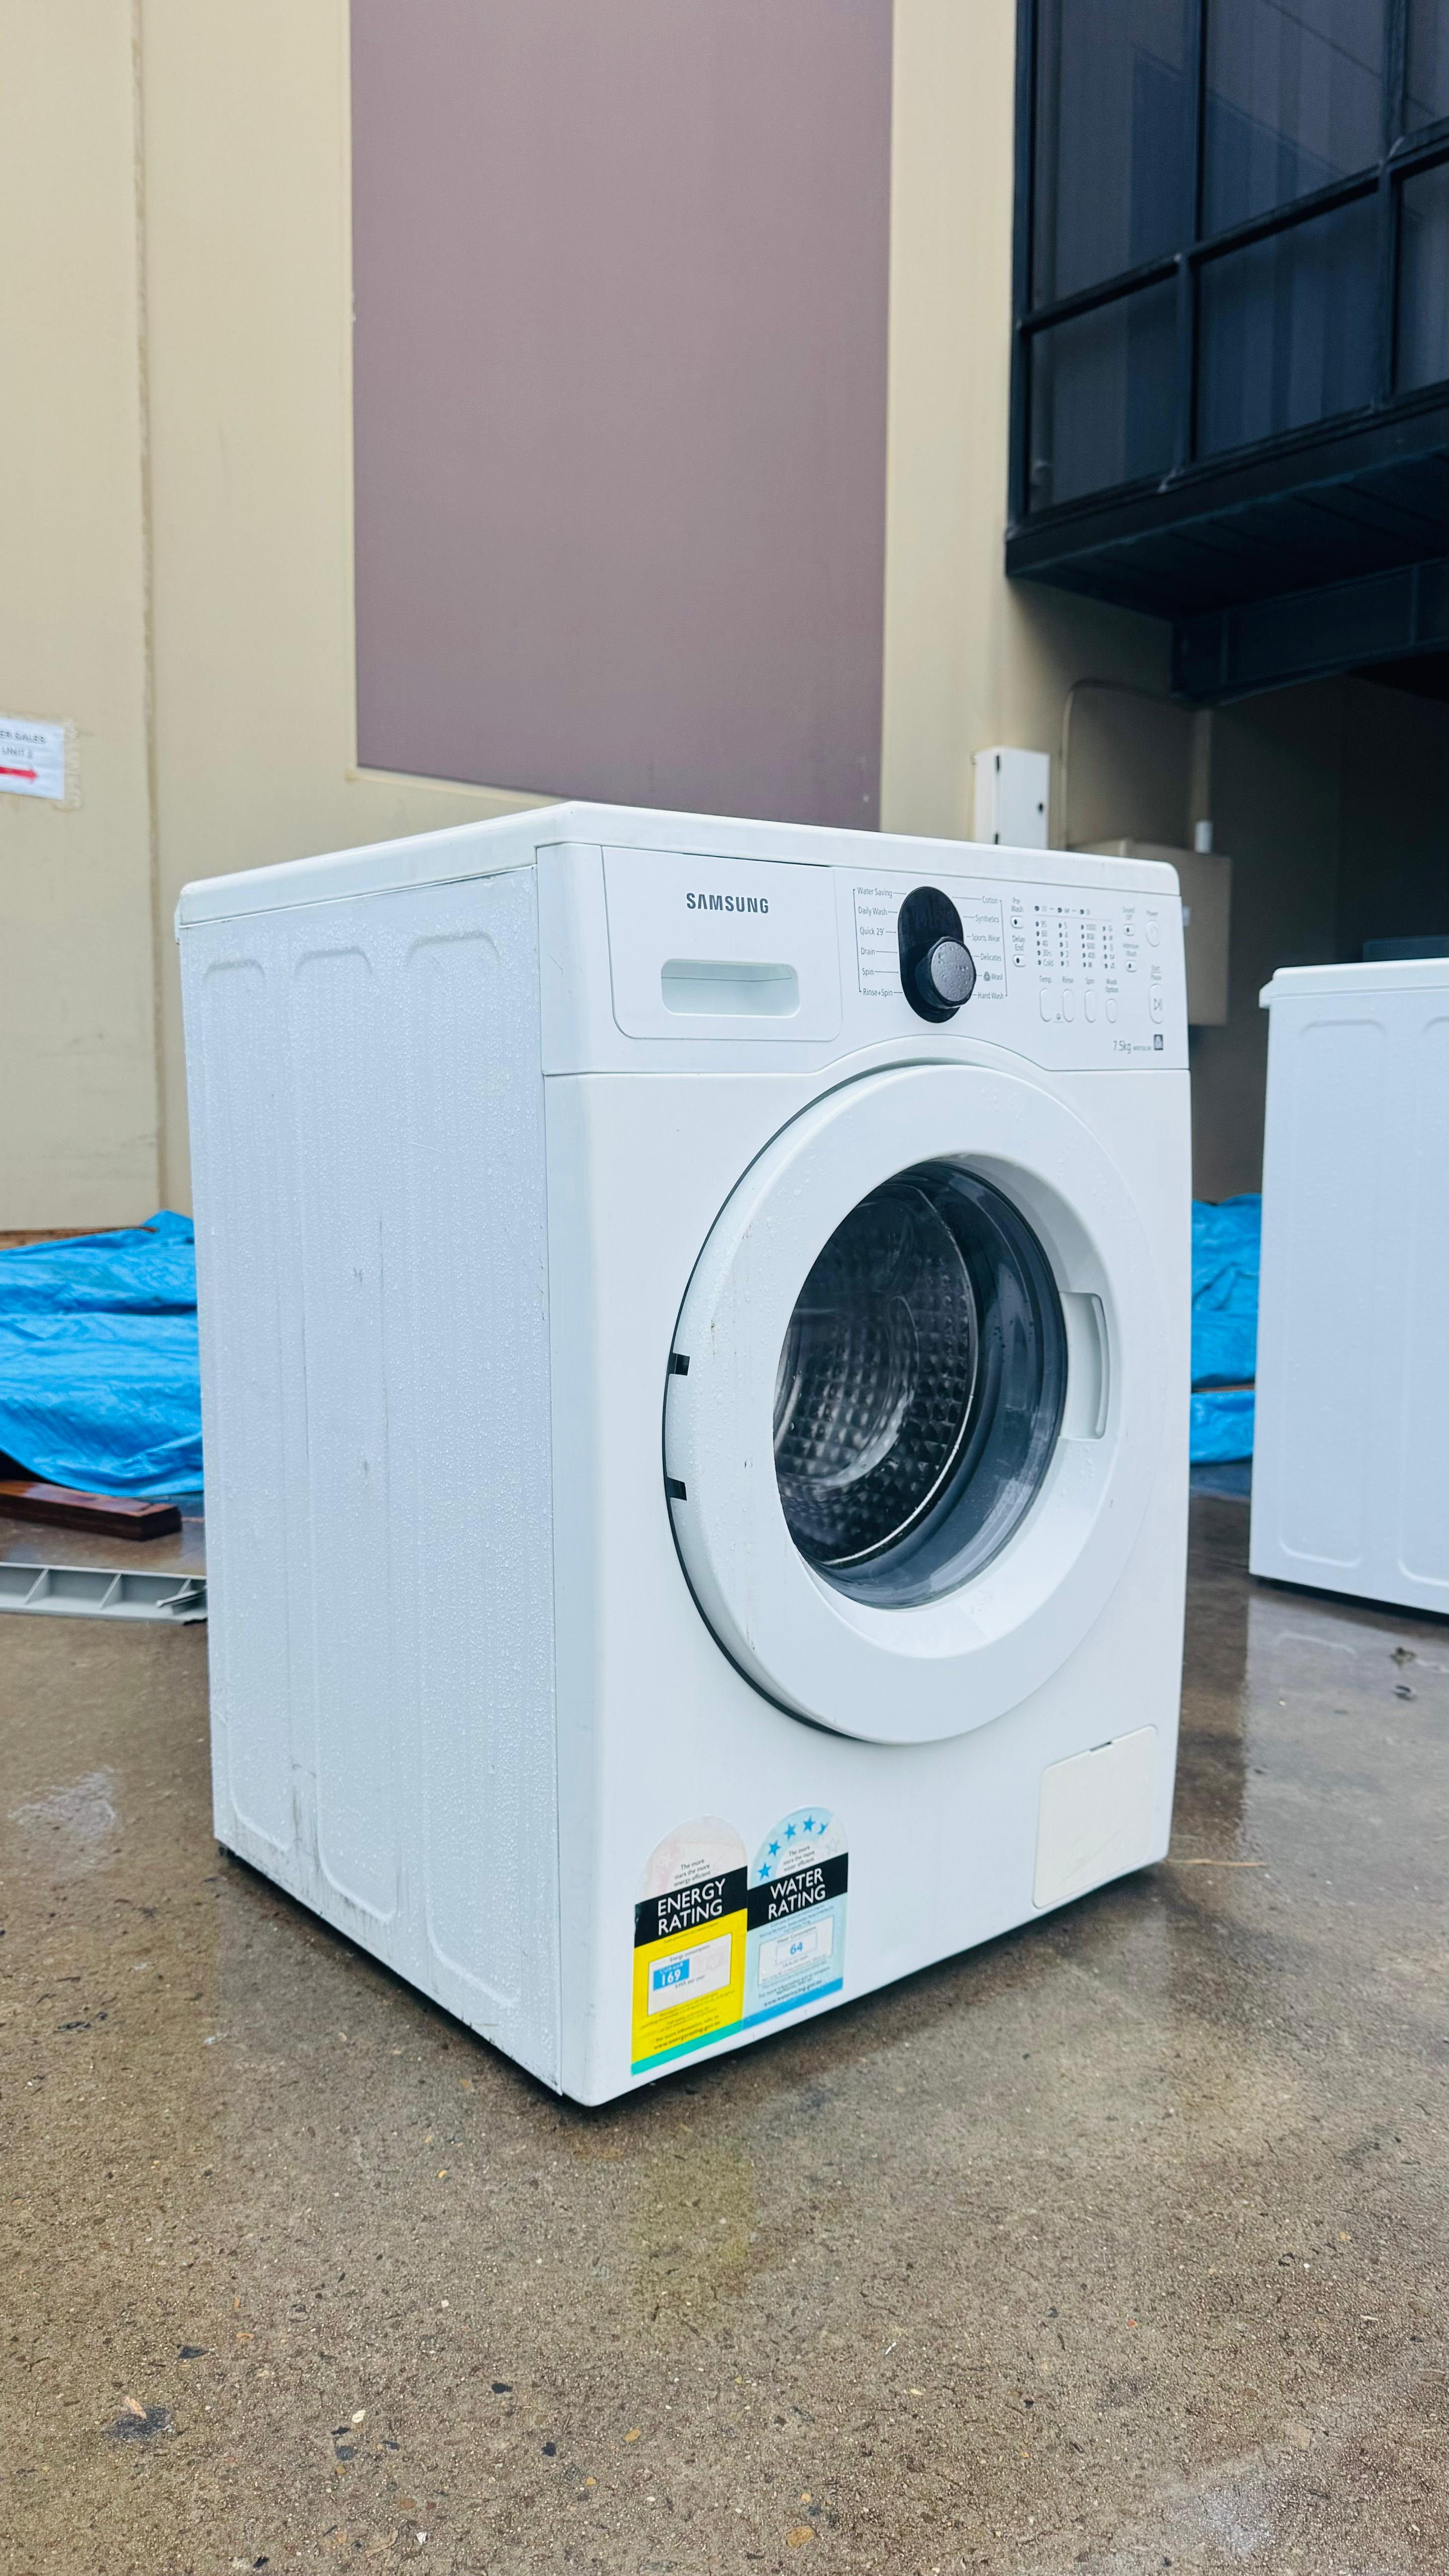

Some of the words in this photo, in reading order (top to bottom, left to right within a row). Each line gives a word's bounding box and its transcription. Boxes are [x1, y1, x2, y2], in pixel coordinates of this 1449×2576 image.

[14, 732, 46, 744] SALES
[857, 887, 873, 895] Water
[875, 888, 893, 898] Saving
[686, 893, 769, 914] SAMSUNG
[982, 896, 998, 904] Cotton
[858, 907, 871, 916] Daily
[976, 915, 999, 923] Synthetics
[860, 927, 875, 935] Quick
[972, 934, 987, 942] Sports
[1012, 935, 1025, 945] Delay
[980, 953, 1001, 961] Delicates
[862, 968, 874, 977] Spin
[863, 988, 893, 997] Rinse+Spin
[691, 1859, 704, 1867] more
[797, 1858, 815, 1866] efficient
[674, 1878, 690, 1887] energy
[692, 1871, 710, 1881] efficient
[770, 1868, 824, 1899] WATER
[658, 1878, 726, 1916] ENERGY
[768, 1884, 826, 1920] RATING
[659, 1899, 722, 1936] RATING
[790, 1942, 802, 1956] 64
[662, 1969, 681, 1986] 169
